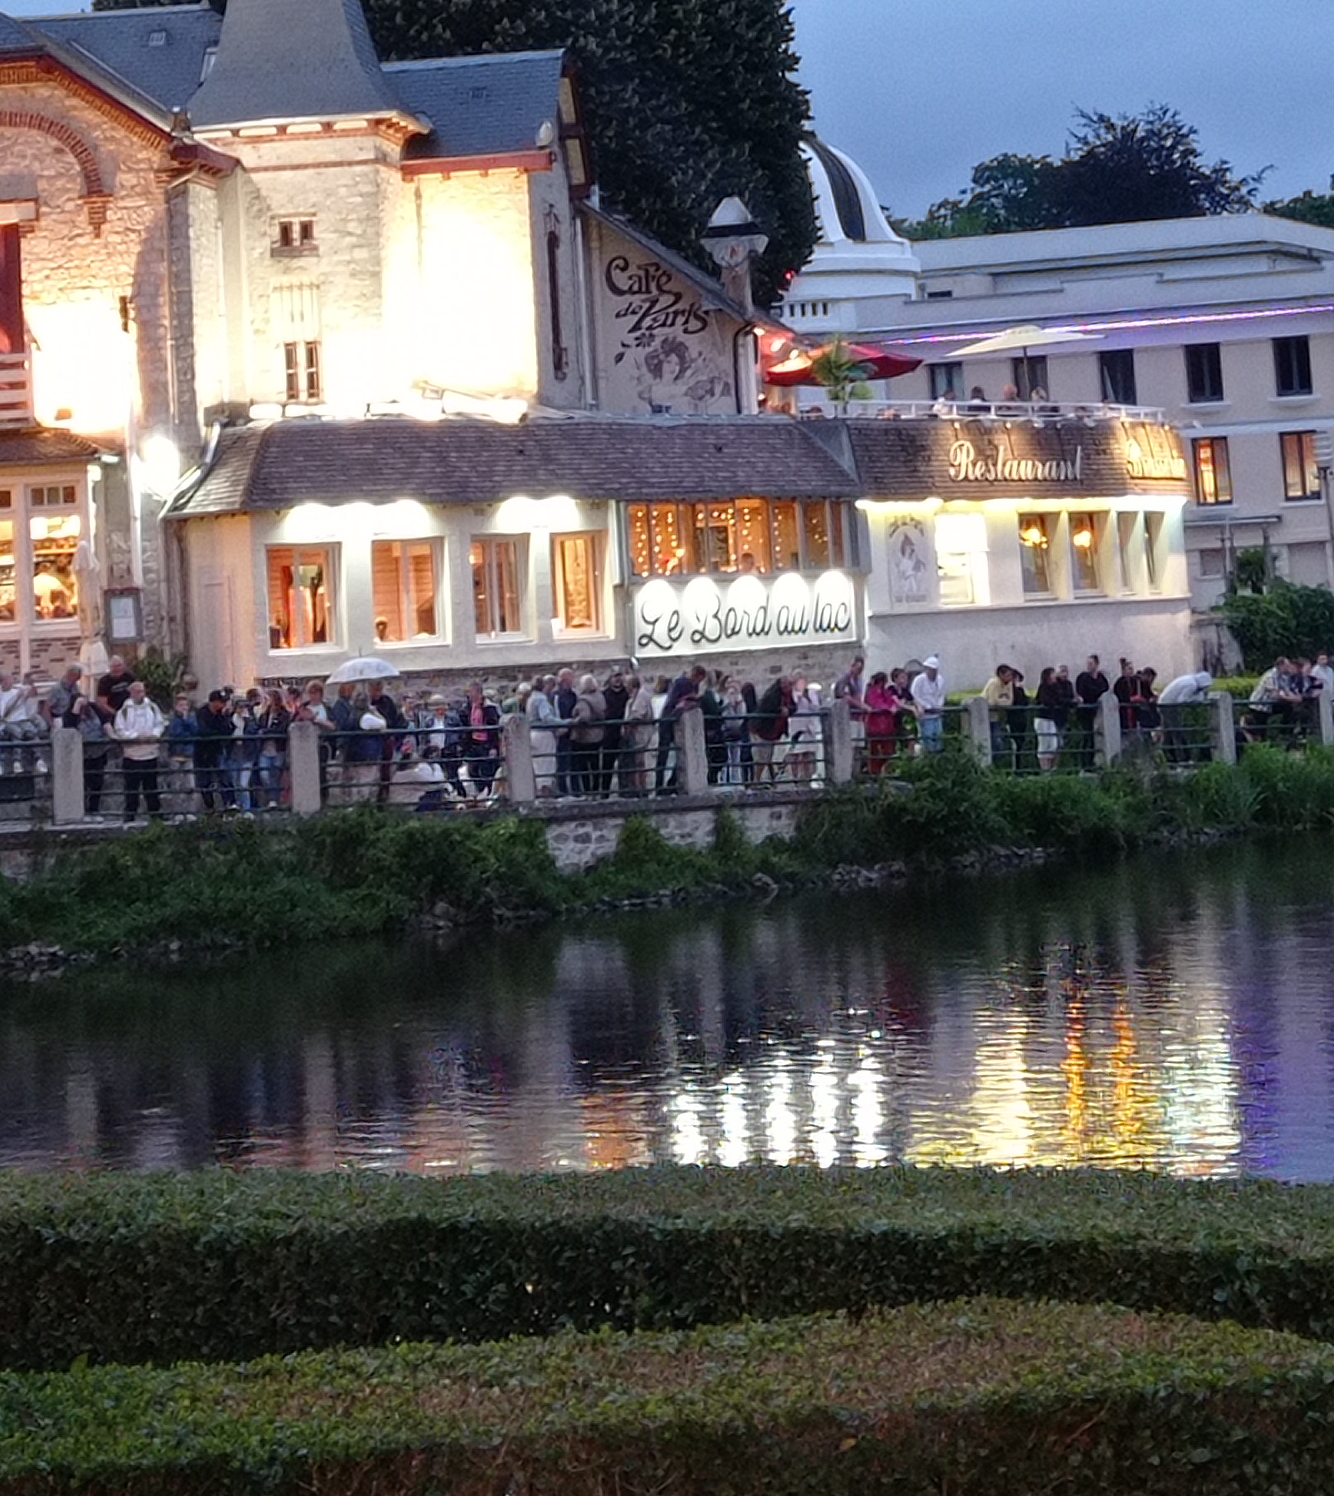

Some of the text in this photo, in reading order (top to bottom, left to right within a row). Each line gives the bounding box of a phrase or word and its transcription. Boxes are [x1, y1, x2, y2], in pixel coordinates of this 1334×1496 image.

[615, 295, 709, 335] de Paris
[948, 440, 1082, 481] Restaurant
[638, 592, 851, 651] Le Bord au lac
